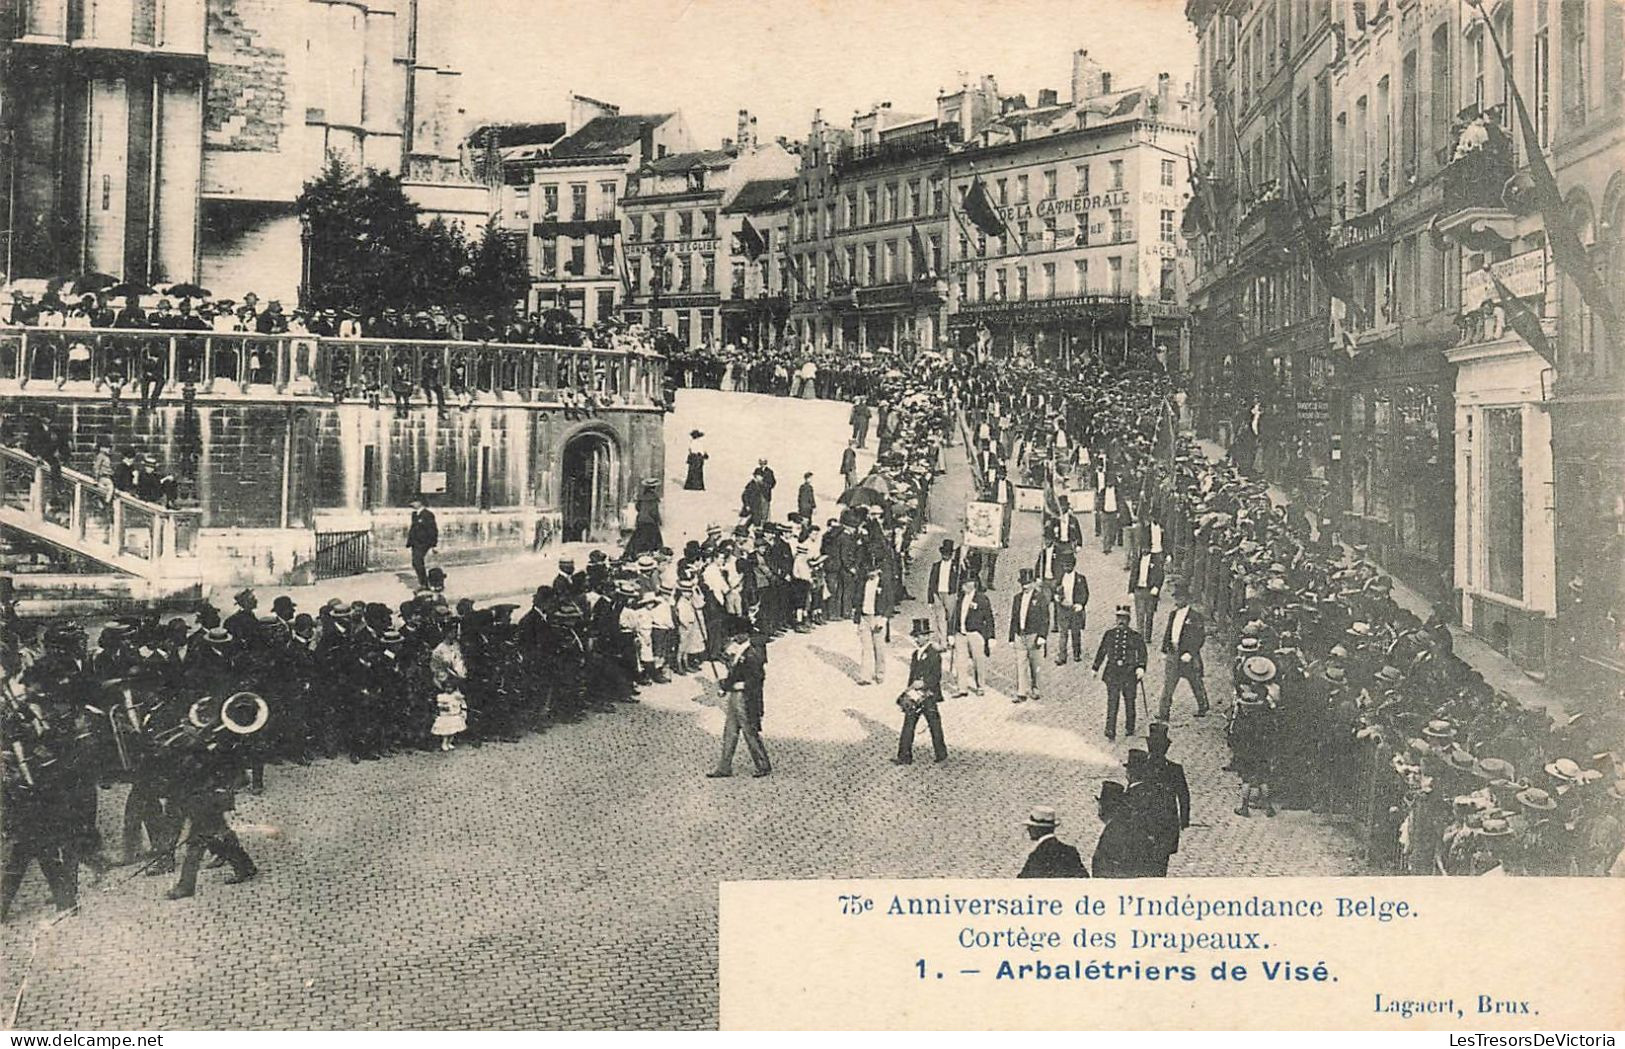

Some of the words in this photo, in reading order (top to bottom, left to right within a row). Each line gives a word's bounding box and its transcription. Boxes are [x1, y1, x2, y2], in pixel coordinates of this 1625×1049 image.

[1017, 206, 1033, 221] LA
[1036, 190, 1131, 217] CATHEDRALE
[1051, 297, 1094, 307] DENTELLES
